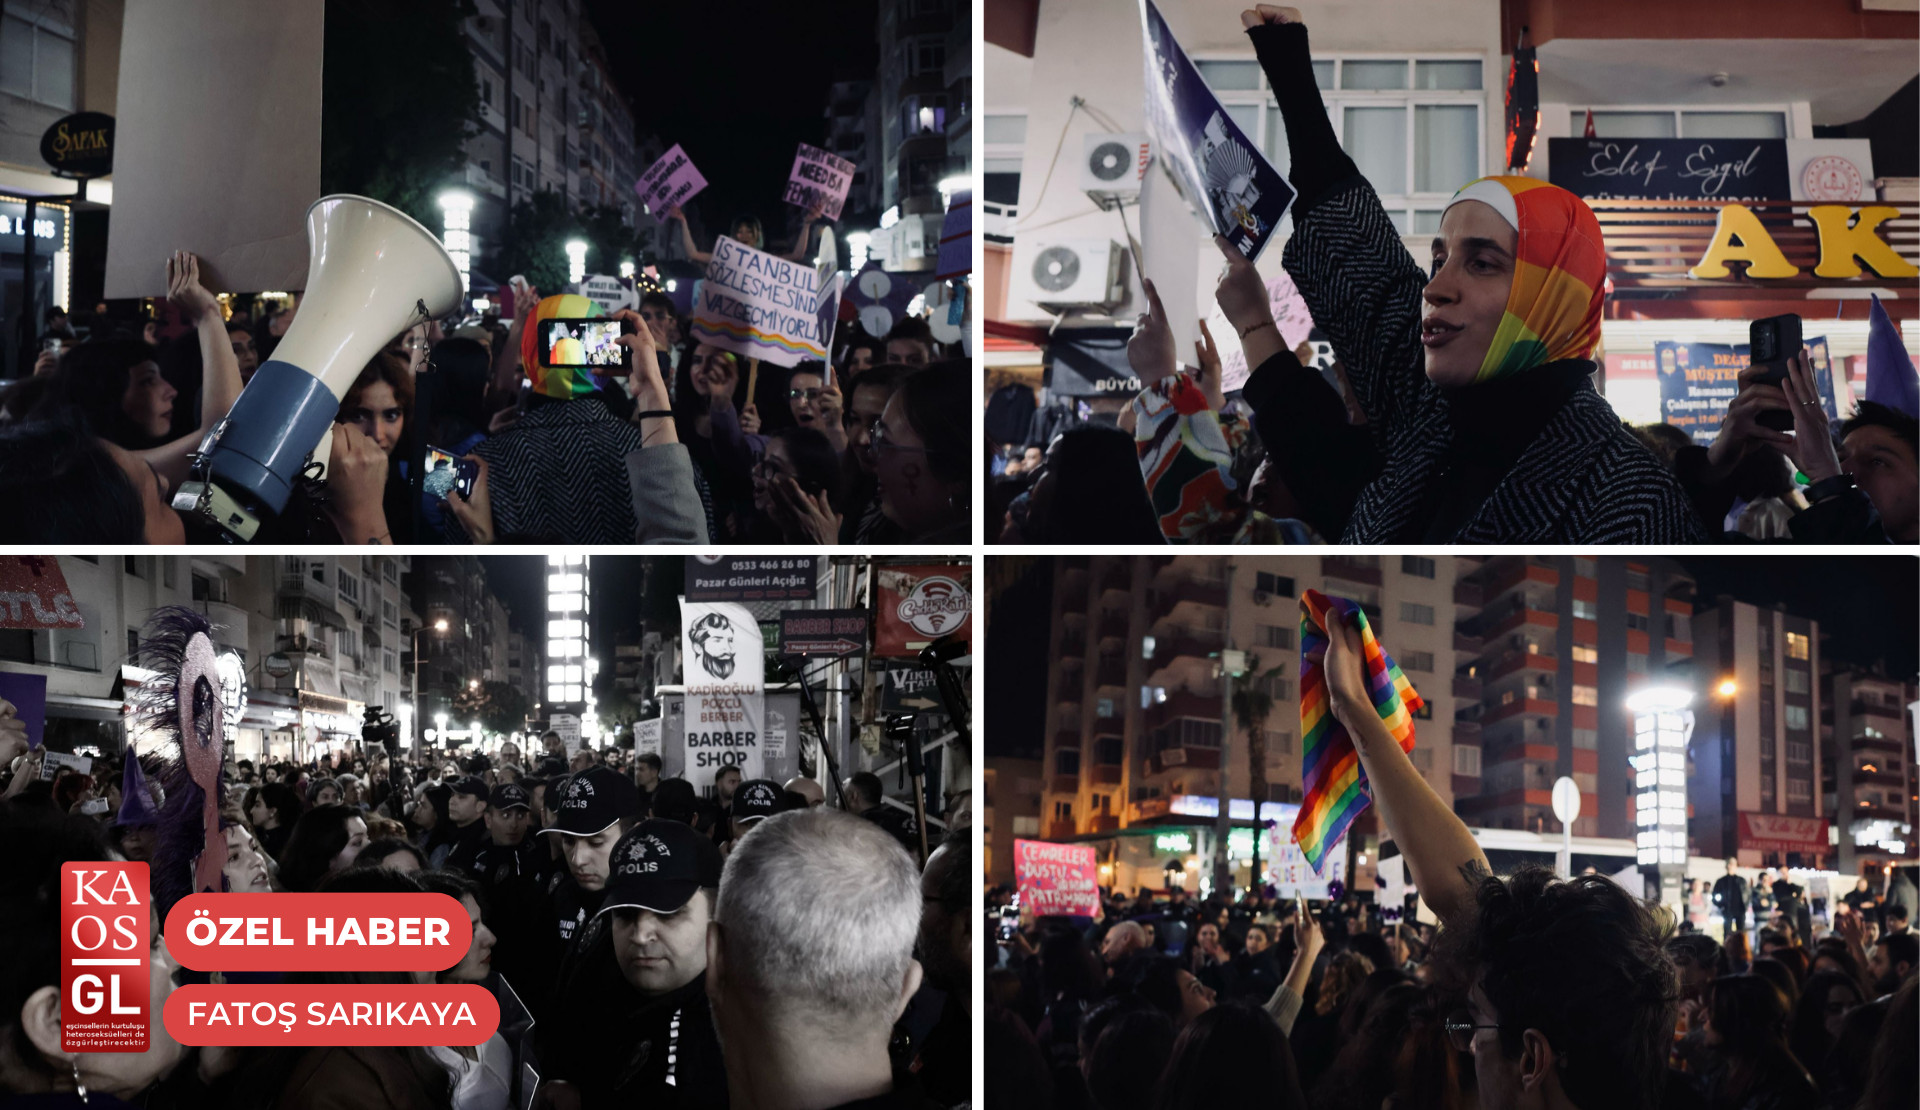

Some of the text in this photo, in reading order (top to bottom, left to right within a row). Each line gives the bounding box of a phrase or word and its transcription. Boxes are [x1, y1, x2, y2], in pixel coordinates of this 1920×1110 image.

[797, 161, 829, 185] NEED
[15, 216, 56, 239] LNS
[716, 237, 818, 294] İSTANBUL
[731, 559, 811, 571] 0533 466 26 80
[695, 574, 806, 588] Pazar Günleri Açığız
[784, 616, 866, 636] BARBER SHOP
[687, 682, 756, 697] KADİROĞLU
[701, 698, 742, 709] POZCU
[700, 711, 743, 723] BERBER
[688, 731, 757, 748] BARBER
[696, 750, 748, 767] SHOP
